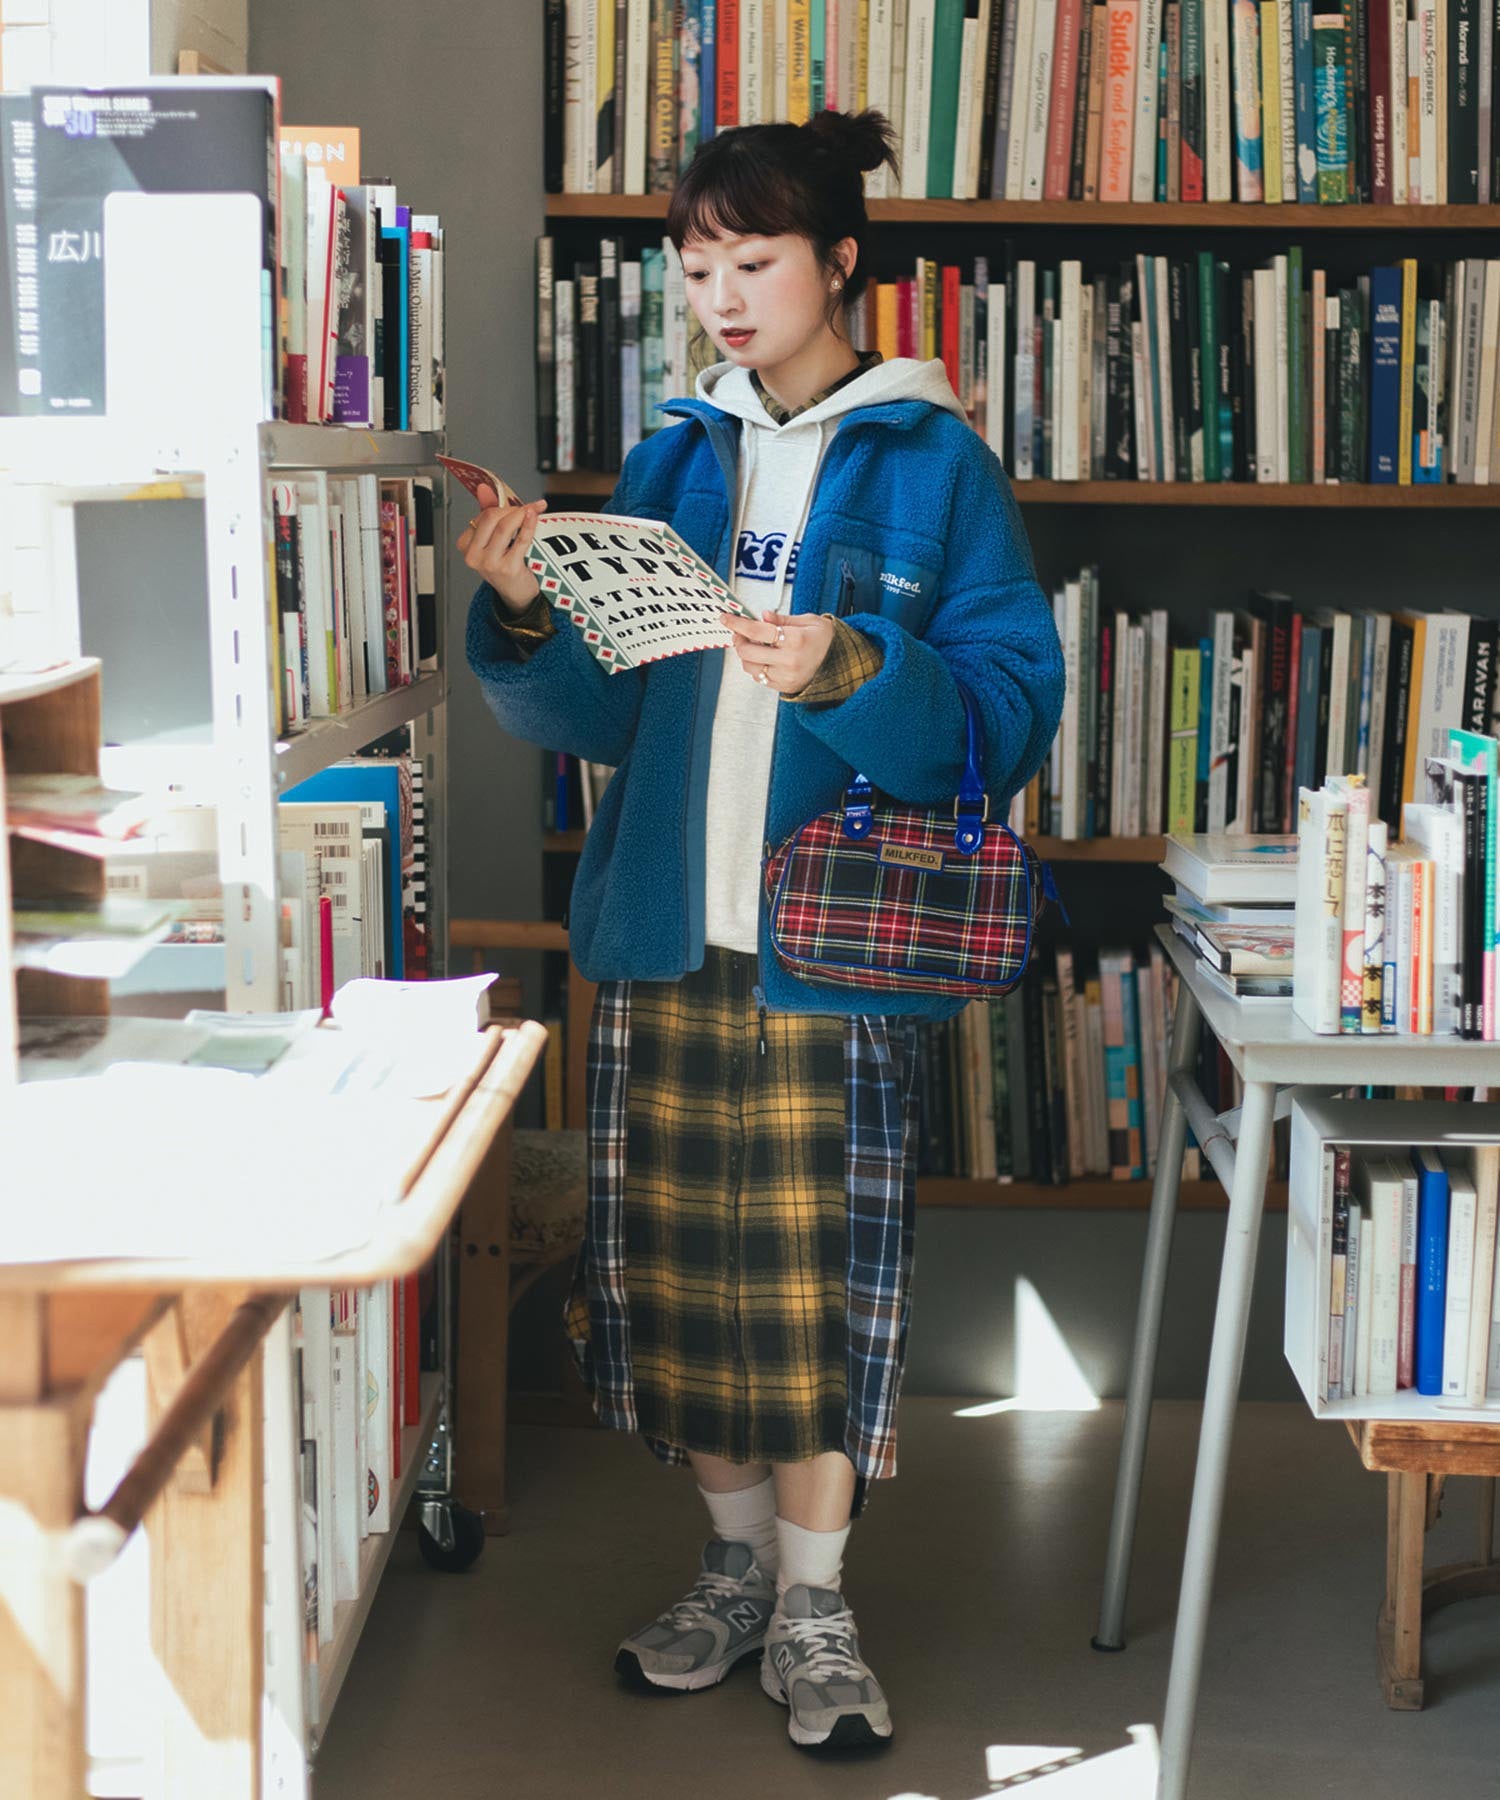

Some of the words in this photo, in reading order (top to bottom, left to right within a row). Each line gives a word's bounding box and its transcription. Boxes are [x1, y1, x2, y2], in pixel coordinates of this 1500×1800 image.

[1185, 1, 1198, 36] David
[792, 18, 806, 81] WARHOL
[1108, 10, 1134, 78] Sudek
[1458, 20, 1470, 65] Morandi
[1034, 52, 1050, 91] Georgia
[1185, 38, 1199, 91] Hockney
[1032, 92, 1047, 134] O'Keeffe
[1112, 83, 1129, 113] and
[65, 110, 94, 137] 30
[655, 98, 673, 149] OTTO
[1374, 95, 1386, 141] Session
[1106, 119, 1128, 192] Sculpture
[1374, 143, 1386, 188] Portrait
[541, 532, 666, 557] DECO
[562, 556, 693, 582] TYPE
[589, 585, 713, 608] STYLISH
[607, 602, 728, 625] ALPHABETS
[616, 628, 634, 639] OF
[638, 620, 669, 633] THE
[1216, 660, 1229, 714] Alexander
[885, 847, 938, 865] MILKFED.
[727, 1600, 762, 1633] N
[775, 1644, 795, 1676] N
